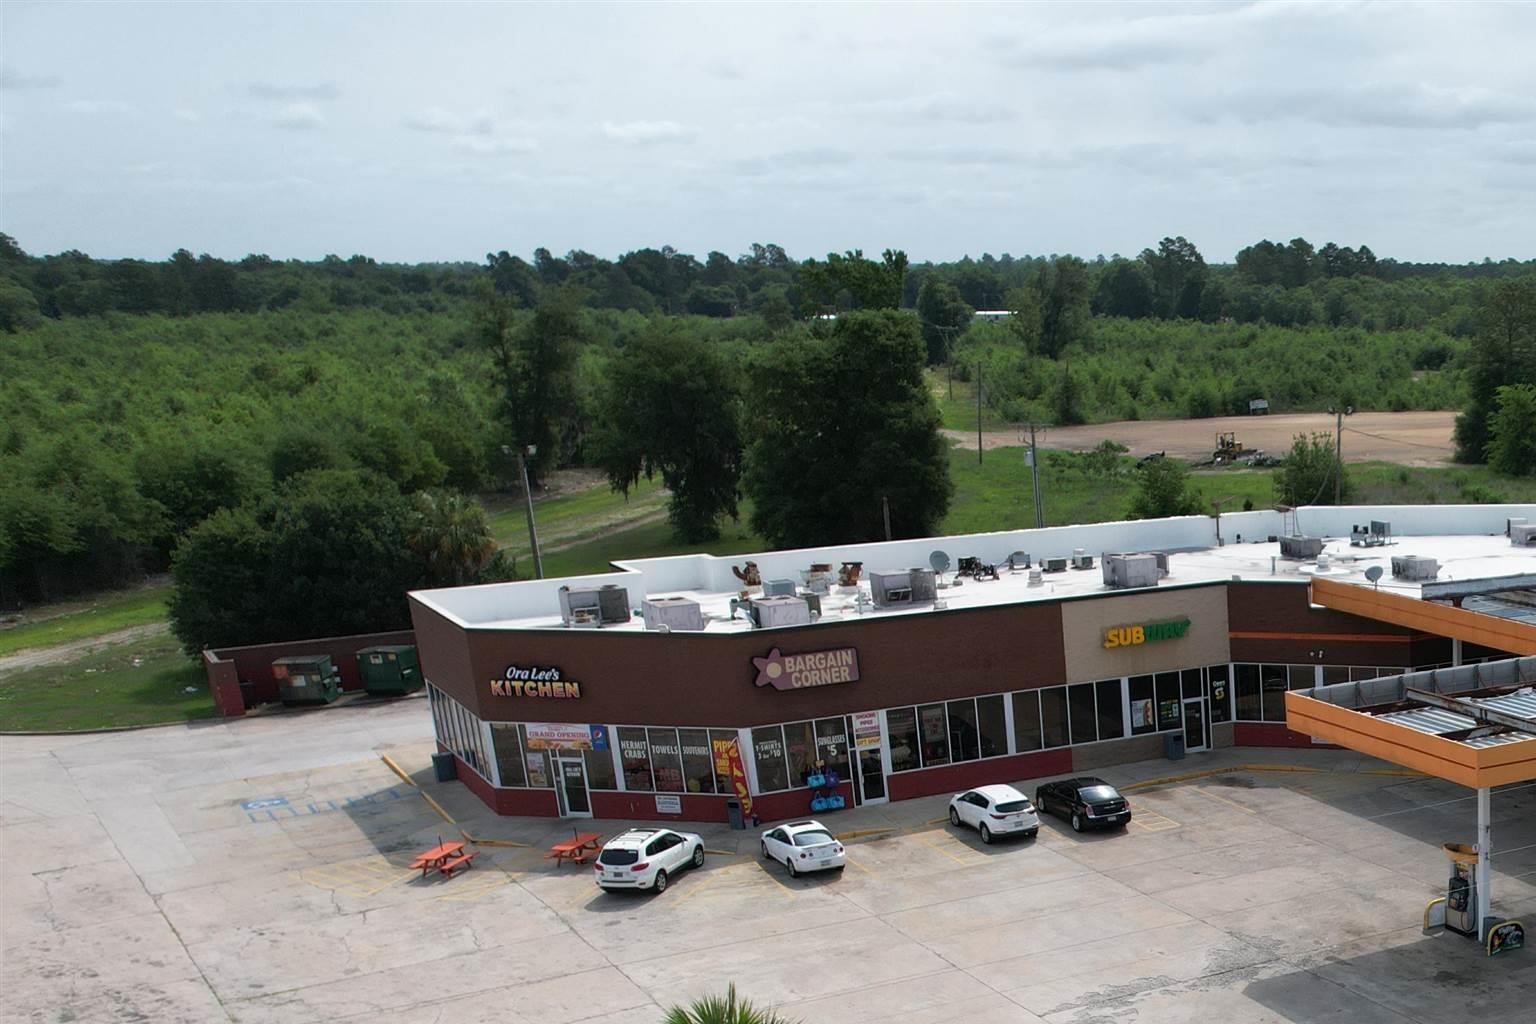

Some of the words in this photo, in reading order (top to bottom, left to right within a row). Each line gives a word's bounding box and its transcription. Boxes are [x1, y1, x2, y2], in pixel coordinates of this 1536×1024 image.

[784, 650, 852, 672] BARGAIN
[506, 666, 529, 679] Ora
[531, 668, 559, 680] Lee's
[791, 667, 850, 688] CORNER
[490, 679, 580, 698] KITCHEN
[620, 740, 647, 750] HERMIT
[651, 744, 679, 755] TOWELS
[624, 749, 646, 759] CRABS
